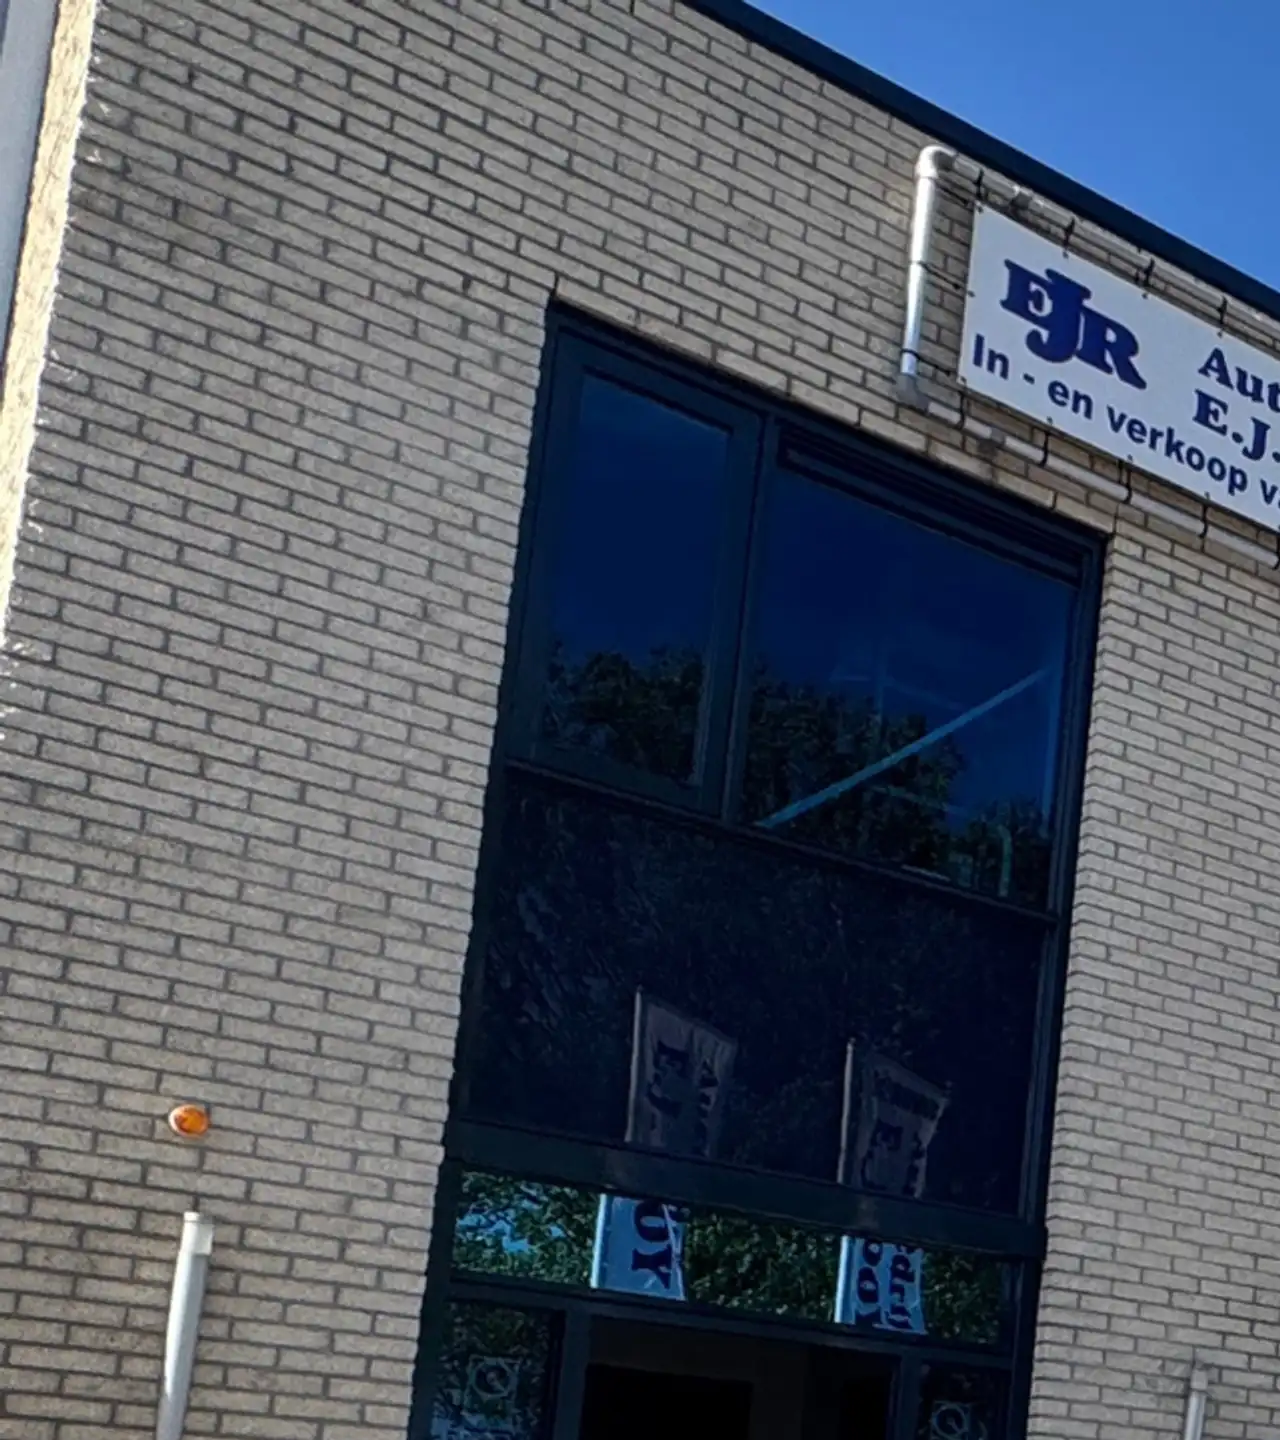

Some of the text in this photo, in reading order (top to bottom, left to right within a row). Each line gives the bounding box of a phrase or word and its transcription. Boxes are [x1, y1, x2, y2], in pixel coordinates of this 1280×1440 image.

[999, 259, 1147, 390] EJR
[972, 333, 1009, 380] In
[1048, 380, 1093, 419] en
[1107, 404, 1248, 496] verkoop
